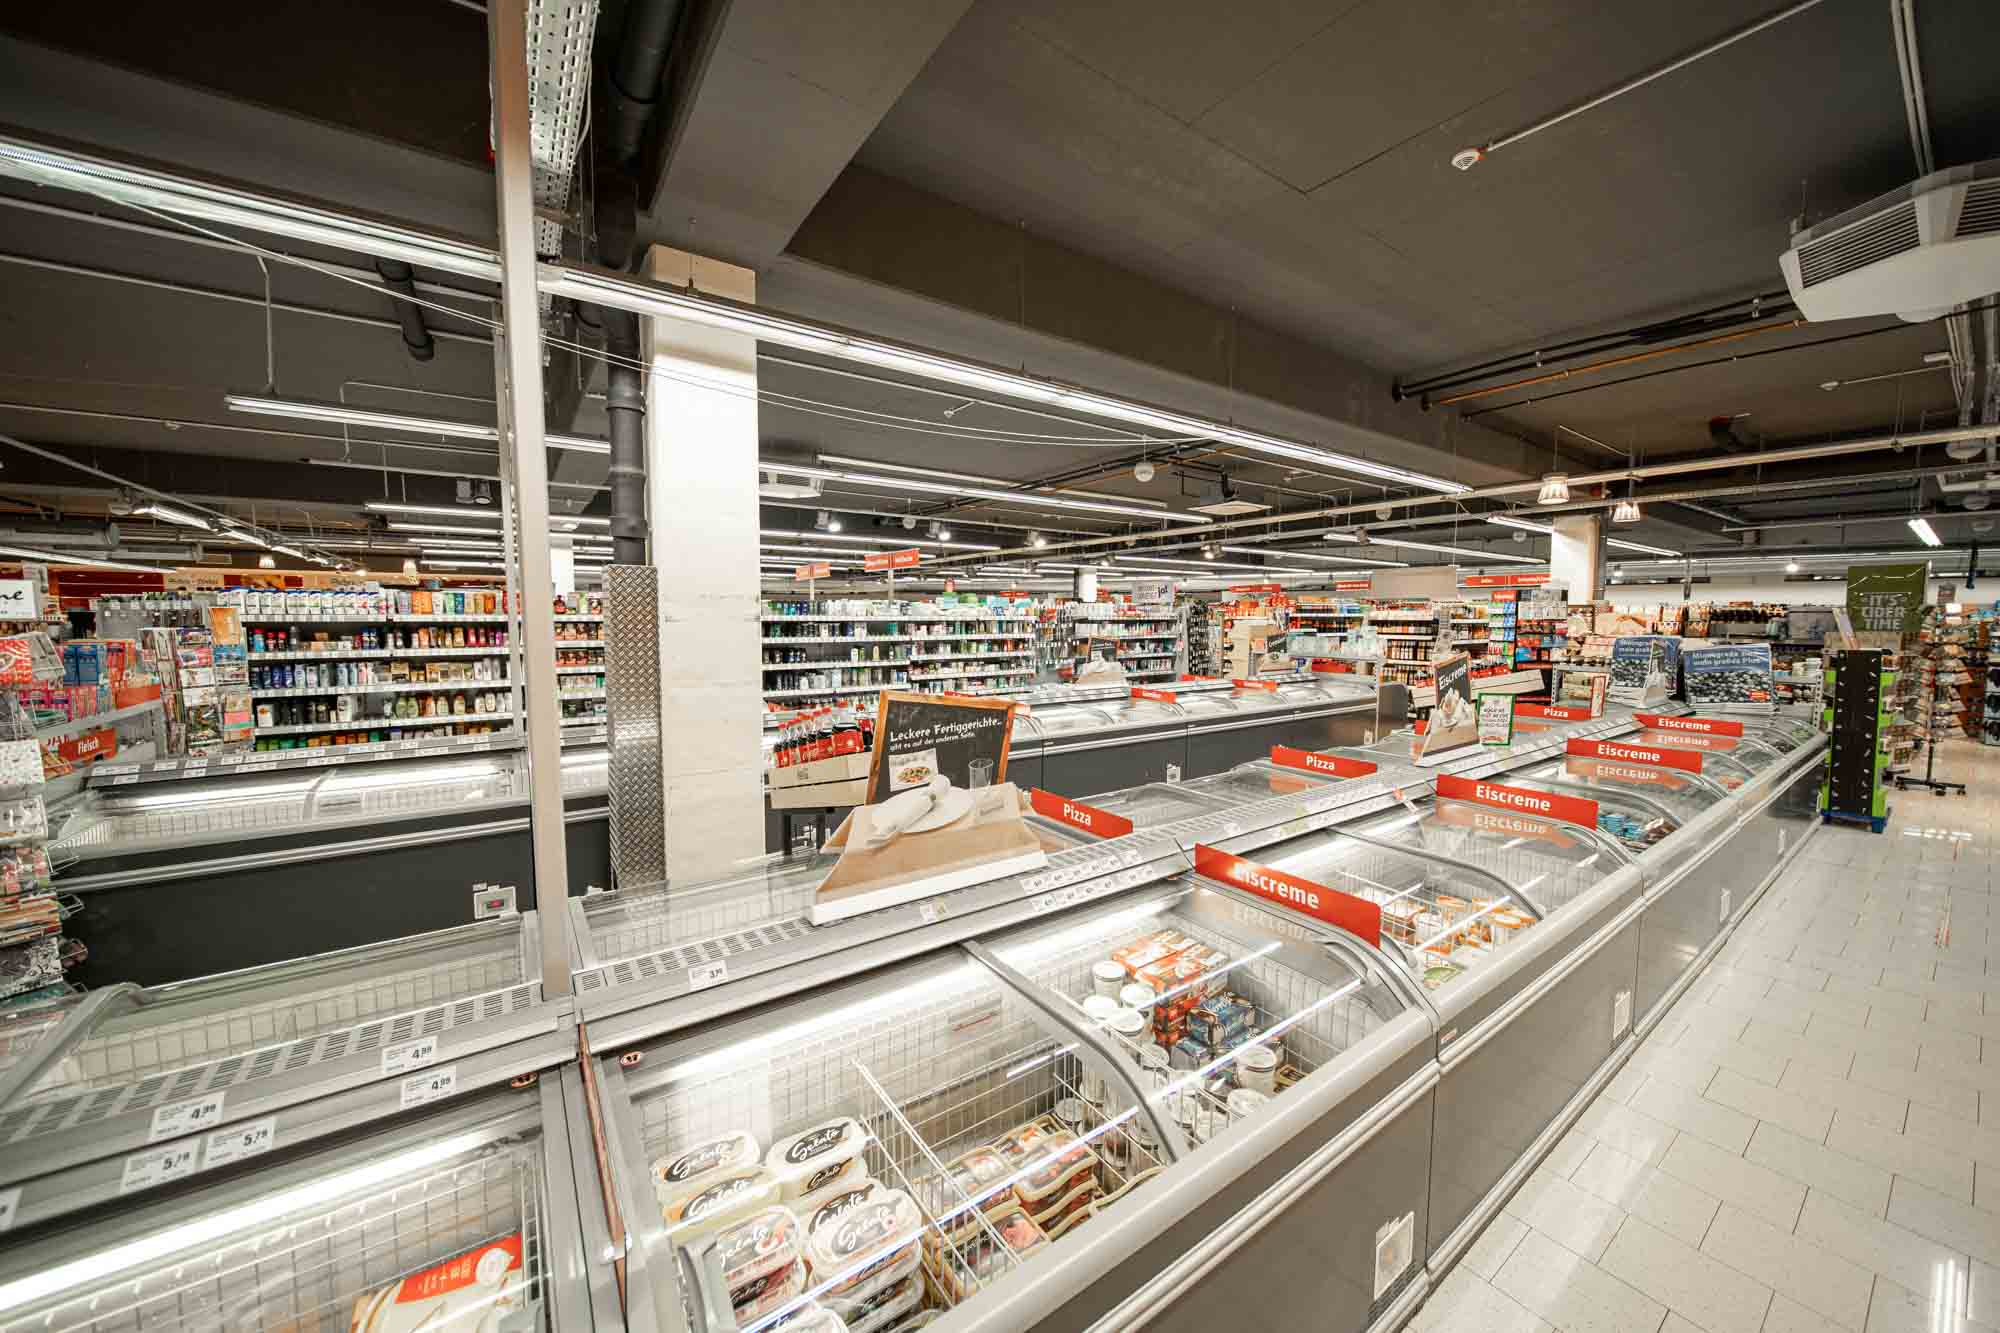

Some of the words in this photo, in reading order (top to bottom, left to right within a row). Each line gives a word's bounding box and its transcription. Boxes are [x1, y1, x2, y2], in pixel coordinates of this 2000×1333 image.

[1864, 618, 1904, 631] TIME
[1439, 663, 1467, 690] Eiscreme
[1543, 708, 1569, 718] Pizza
[1657, 718, 1712, 731] Eiscreme
[890, 728, 931, 742] Leckere
[1597, 744, 1661, 762] Eiscreme
[1305, 755, 1336, 771] Pizza
[1475, 784, 1551, 812] Eiscreme
[1063, 803, 1092, 826] Pizza
